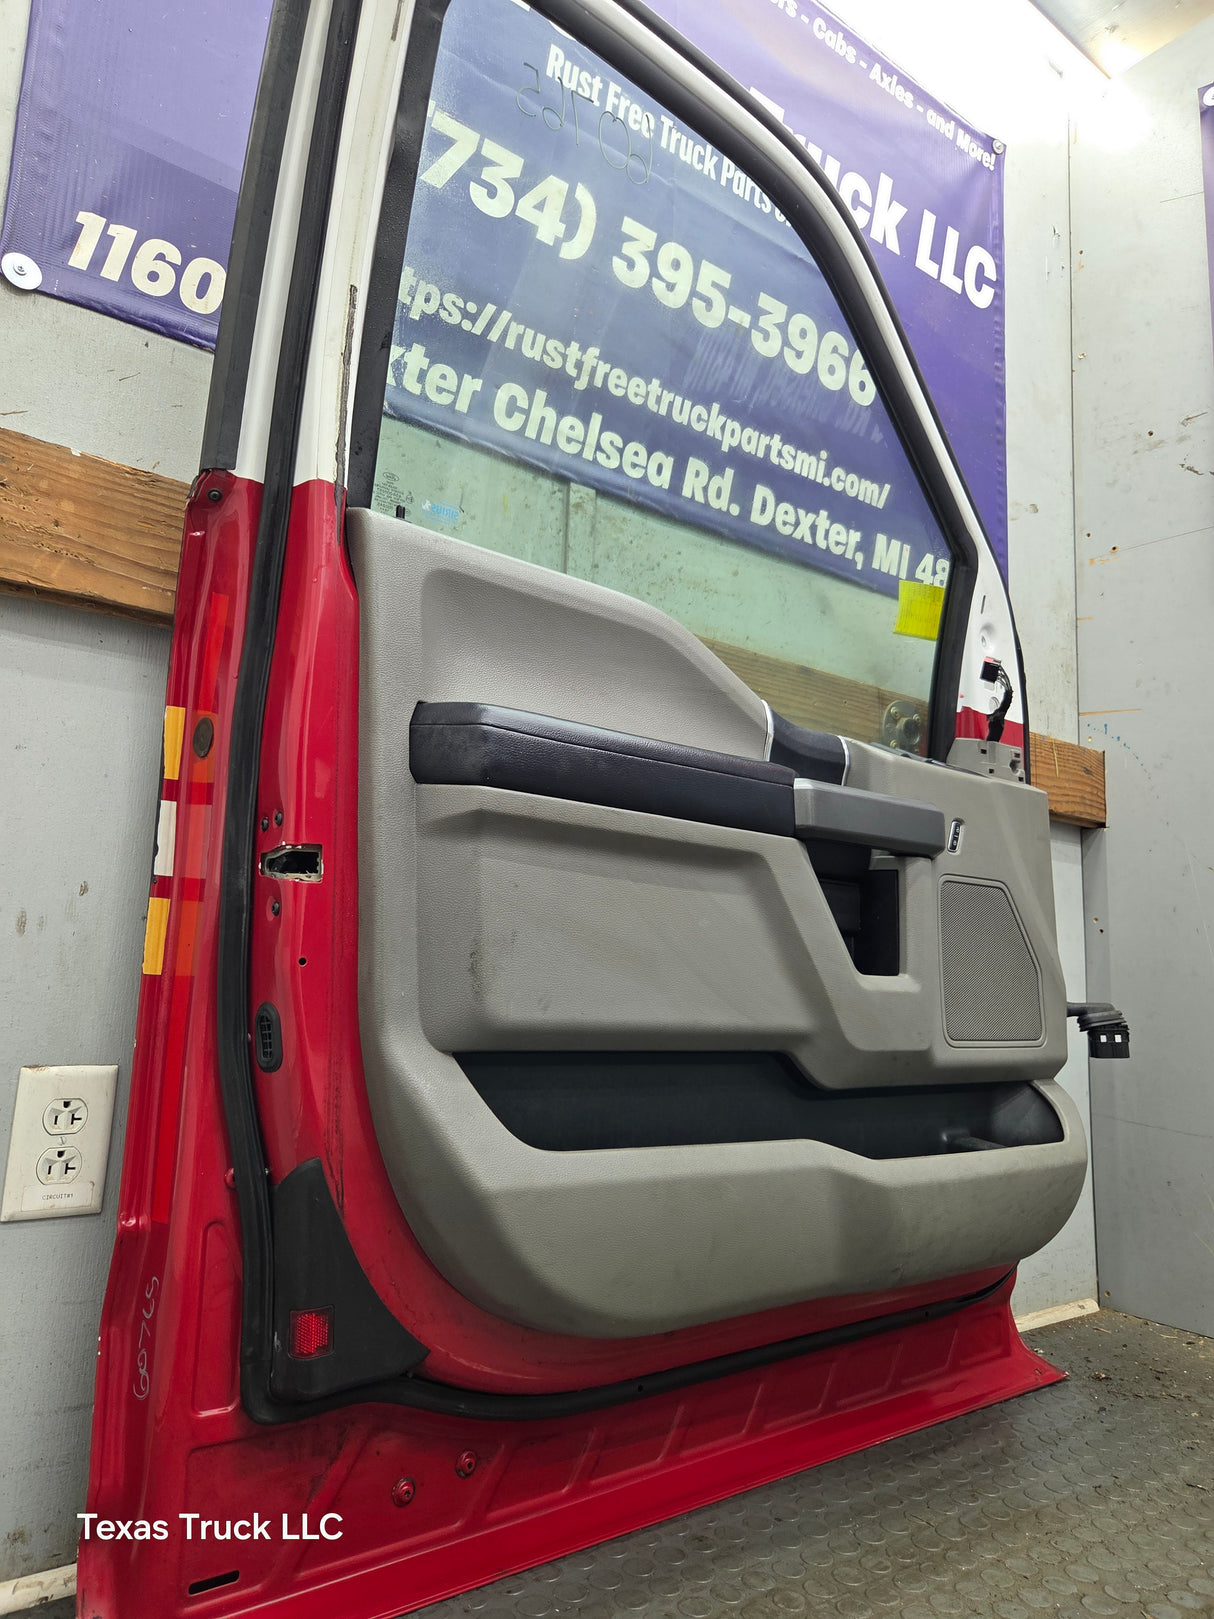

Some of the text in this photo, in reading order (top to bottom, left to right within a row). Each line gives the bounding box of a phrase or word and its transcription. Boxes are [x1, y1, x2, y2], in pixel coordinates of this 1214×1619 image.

[546, 44, 771, 213] Rust Free Truck Parts
[813, 17, 857, 64] Cabs
[869, 62, 914, 109] Axles
[926, 109, 956, 140] and
[956, 131, 996, 171] More!
[67, 210, 227, 315] 1160
[420, 101, 877, 407] 734) 395-3966
[915, 209, 997, 309] LLC
[398, 266, 890, 509] tps://rustfreetruckpartsmi.com/
[493, 382, 673, 490] Chelsea
[682, 456, 740, 517] Rd.
[750, 484, 863, 570] Dexter,
[872, 533, 910, 580] MI
[915, 553, 949, 588] 48
